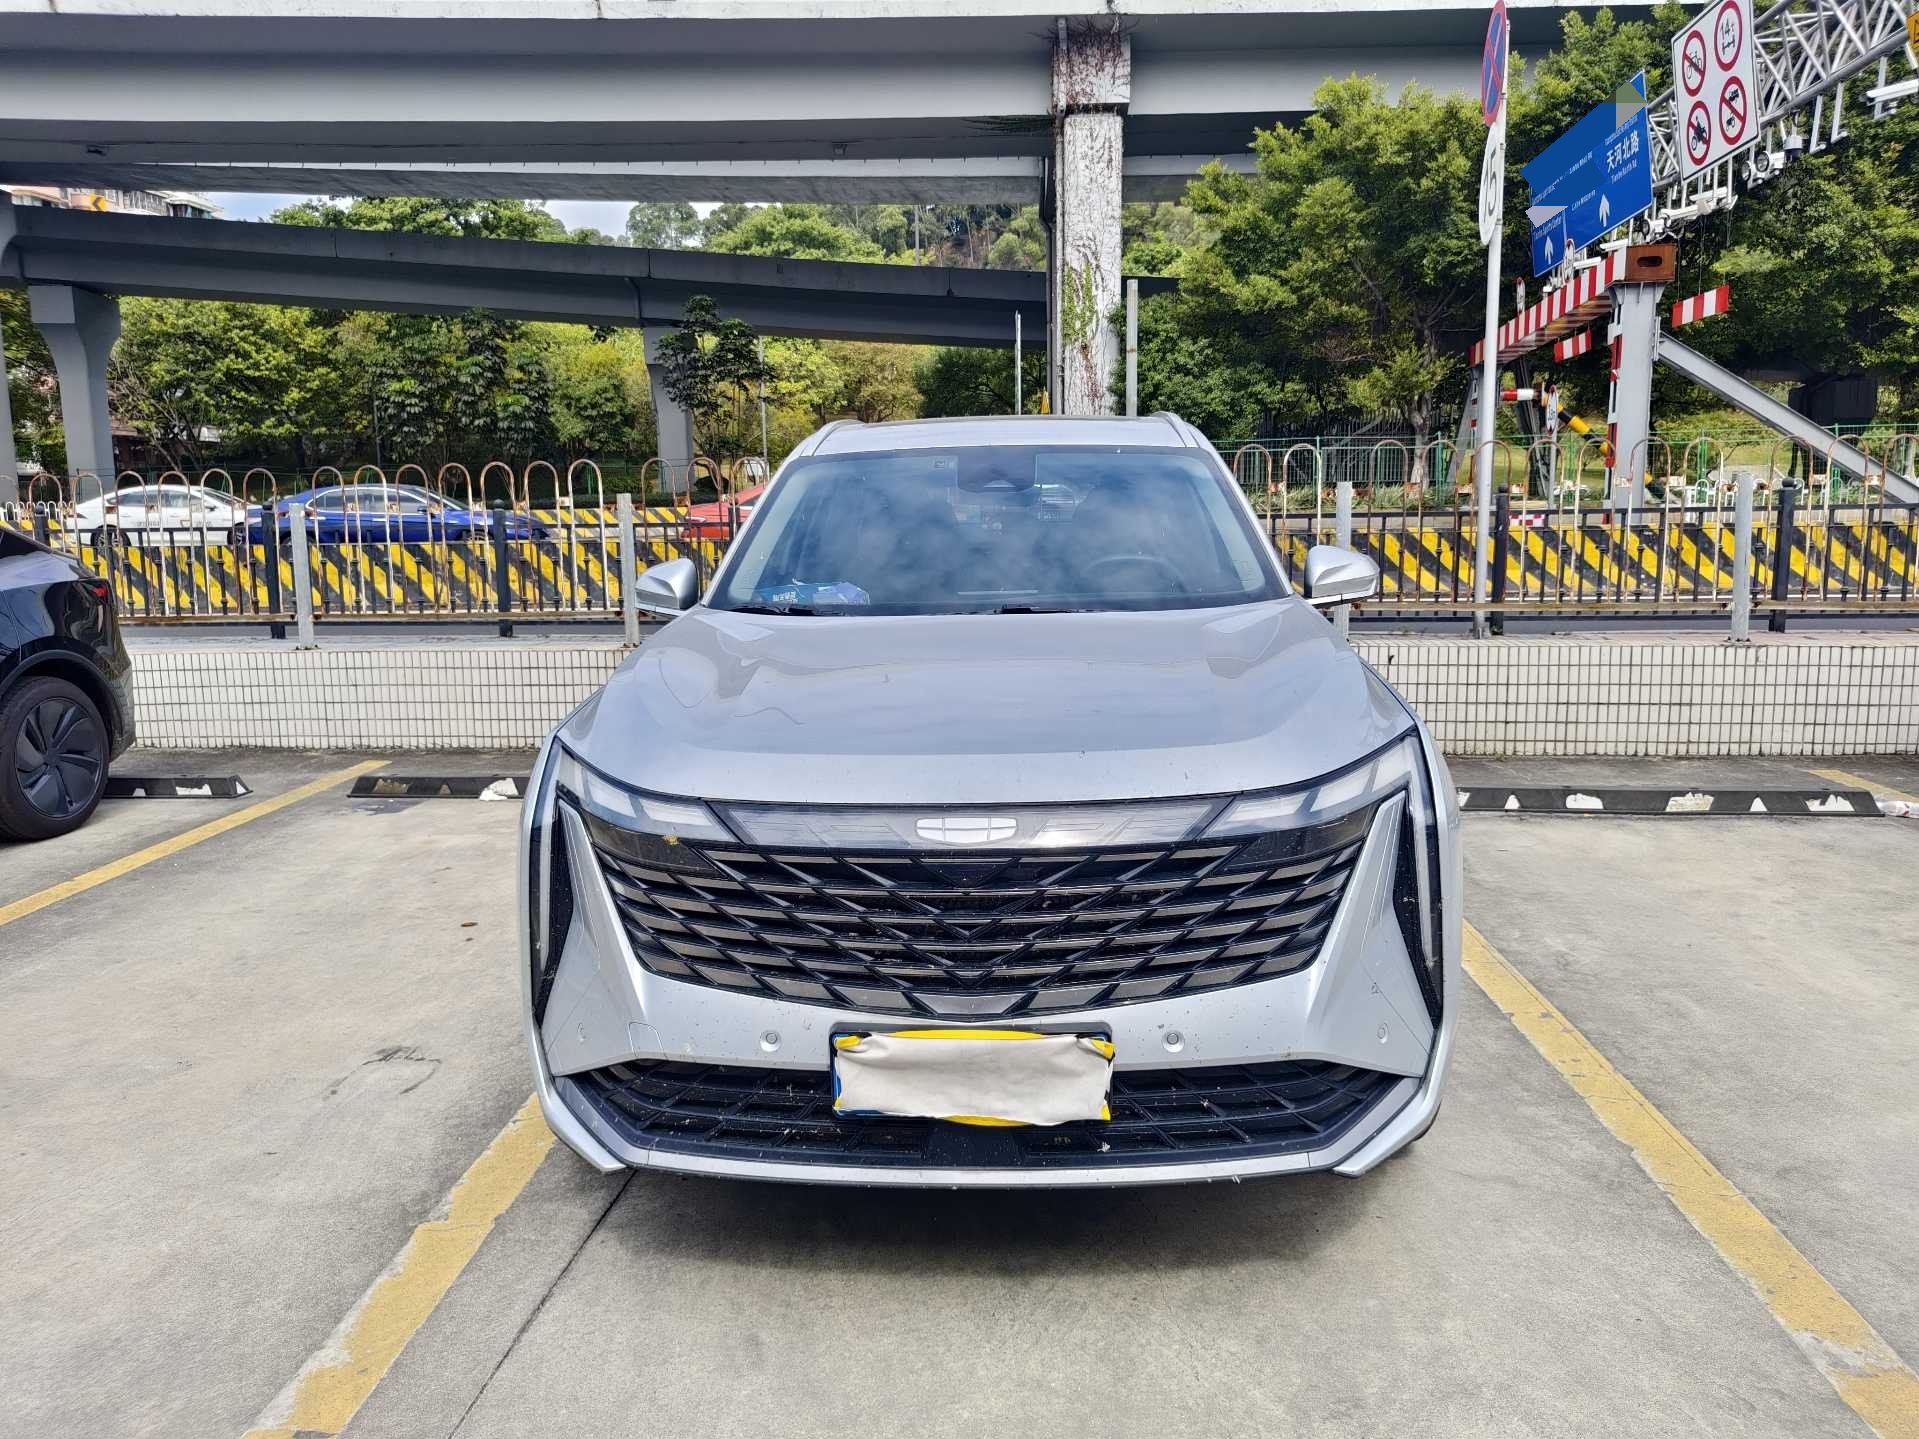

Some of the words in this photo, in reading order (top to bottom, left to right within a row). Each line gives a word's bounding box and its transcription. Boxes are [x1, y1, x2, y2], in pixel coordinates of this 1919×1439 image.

[1606, 129, 1640, 173] 天河北路
[1483, 147, 1497, 224] 15
